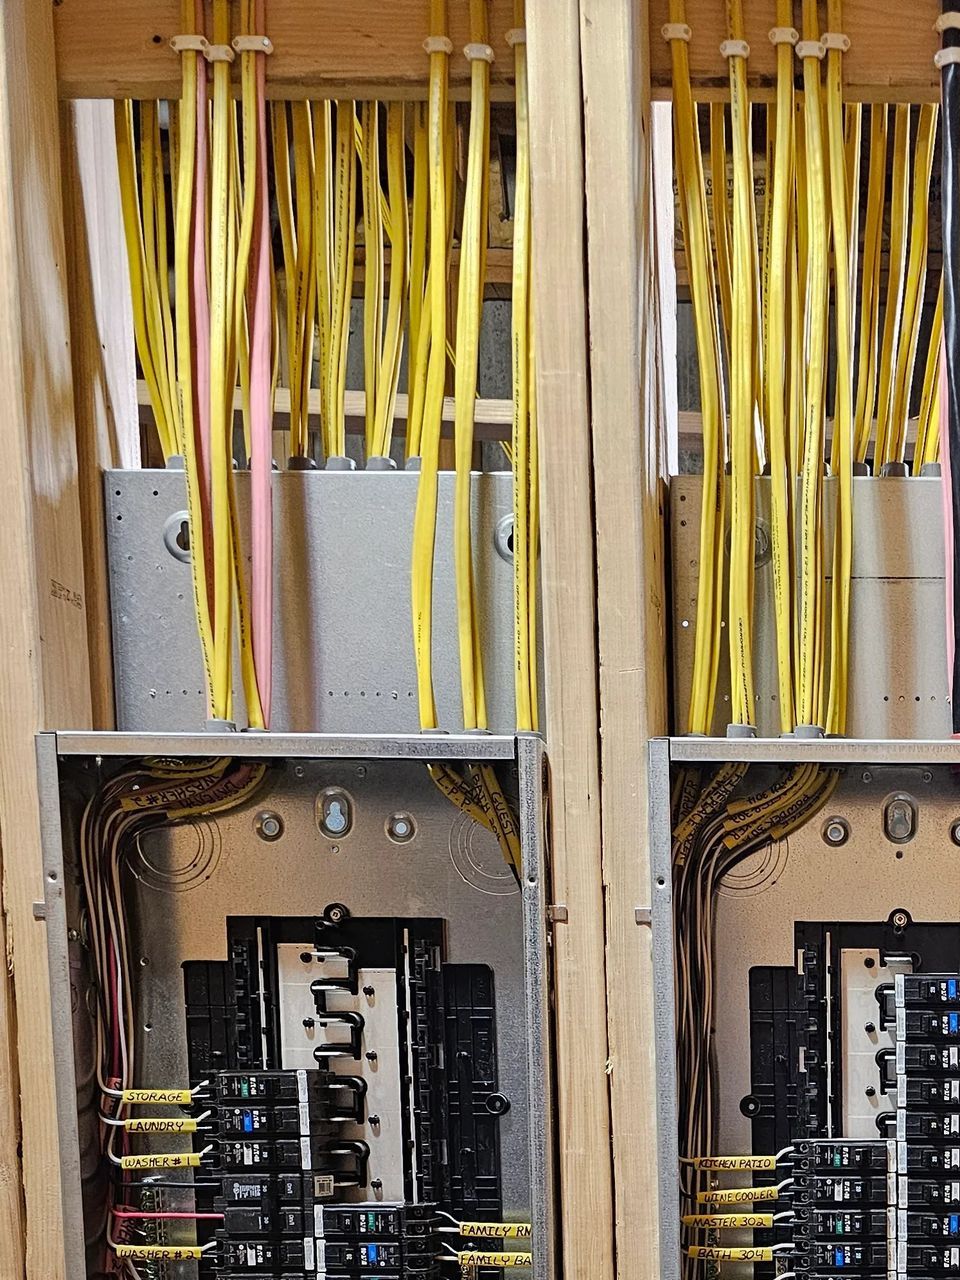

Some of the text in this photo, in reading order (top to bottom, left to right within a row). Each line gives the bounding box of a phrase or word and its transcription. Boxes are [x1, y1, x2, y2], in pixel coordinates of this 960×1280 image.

[127, 1092, 183, 1101] STORAGE
[130, 1121, 184, 1131] LAUNDRY
[124, 1157, 169, 1167] WASHER
[698, 1158, 771, 1169] KITCHEN PATIO
[704, 1189, 774, 1203] WINE COOLER
[693, 1217, 766, 1227] MASTER 302
[461, 1225, 512, 1236] FAMILY
[121, 1249, 170, 1259] WASHER
[698, 1248, 764, 1259] BATH 304
[461, 1255, 510, 1266] FAMILY
